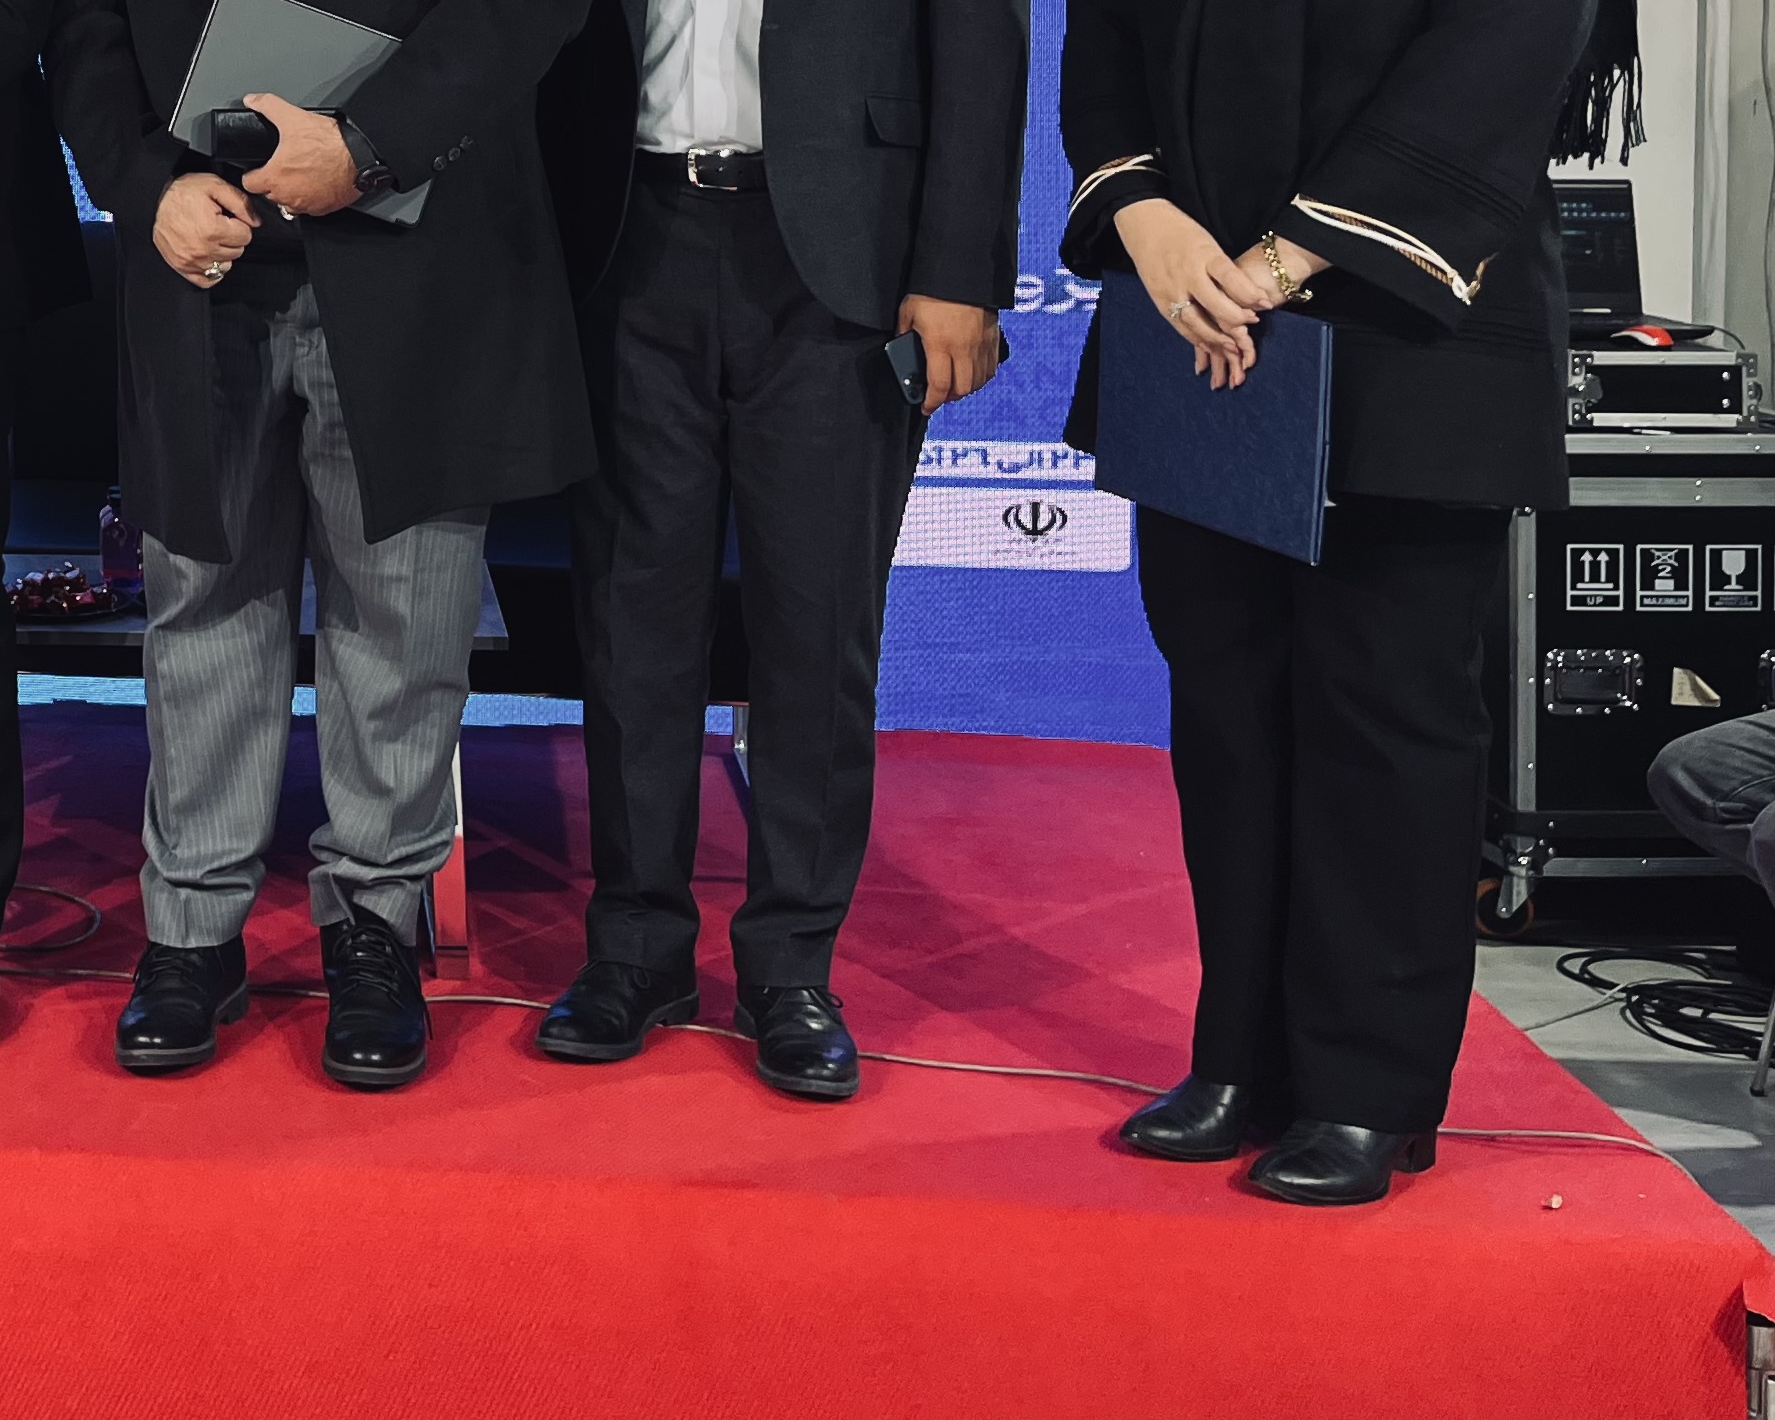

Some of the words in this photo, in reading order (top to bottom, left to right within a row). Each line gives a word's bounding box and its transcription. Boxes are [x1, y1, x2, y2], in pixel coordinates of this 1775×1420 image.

[995, 448, 1044, 475] الی
[1657, 564, 1673, 578] 2
[1586, 595, 1605, 606] UP
